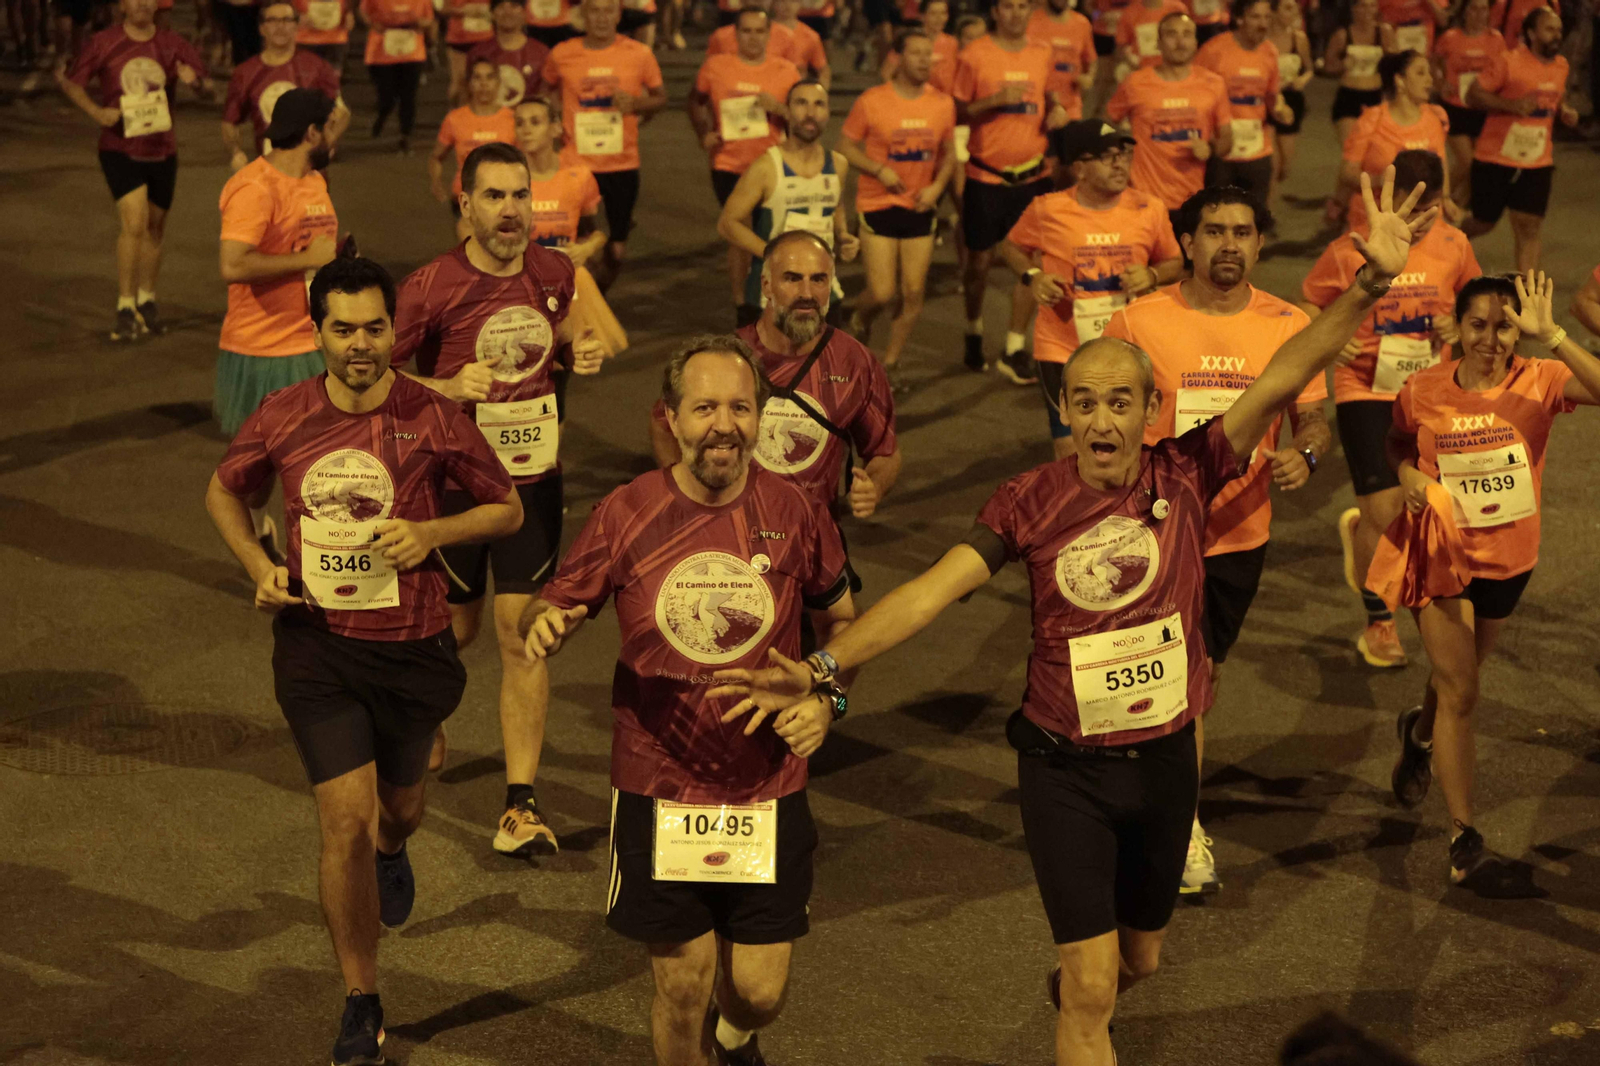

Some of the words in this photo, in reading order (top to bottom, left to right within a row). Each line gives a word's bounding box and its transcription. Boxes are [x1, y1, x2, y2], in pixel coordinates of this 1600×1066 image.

[1086, 233, 1120, 245] XXXV
[1200, 355, 1246, 371] XXXV
[1187, 379, 1250, 389] GUADALQUIV
[1219, 373, 1256, 381] NOCTURN
[766, 410, 790, 418] Camino
[1451, 412, 1495, 431] XXXV
[500, 426, 541, 444] 5352
[1434, 432, 1468, 441] CARRERA
[1471, 426, 1514, 437] NOCTURNA
[1439, 433, 1515, 448] GUADALQUIVIR
[1459, 475, 1515, 494] 17639
[1080, 542, 1107, 551] Camino
[1108, 537, 1118, 545] de
[320, 554, 371, 572] 5346
[679, 555, 700, 569] CONTRA
[676, 581, 684, 589] El
[685, 581, 717, 589] Camino
[730, 581, 753, 589] Elena
[1106, 660, 1164, 691] 5350
[1085, 697, 1109, 706] MARCO
[1109, 691, 1136, 701] ANTONIO
[1130, 701, 1150, 712] KH7
[683, 814, 754, 836] 10495
